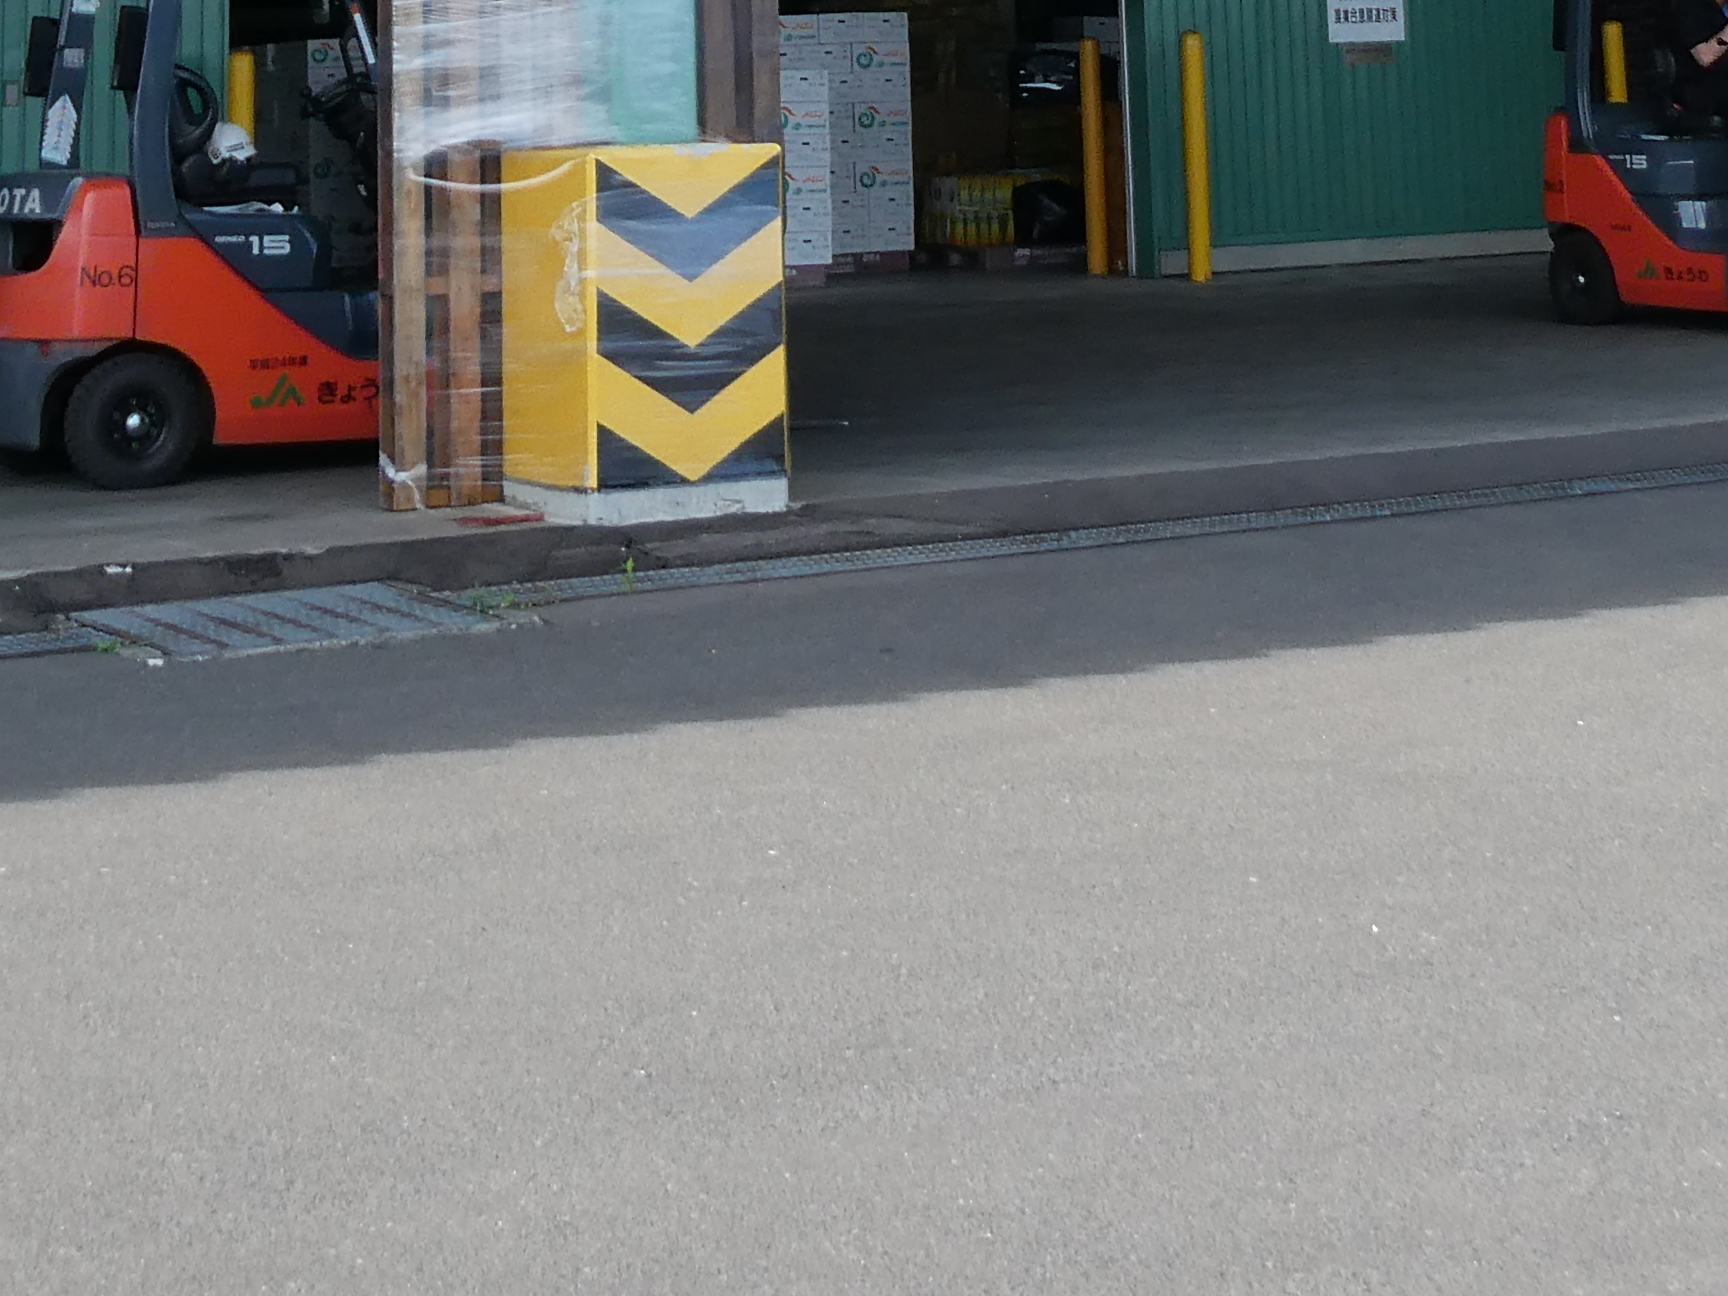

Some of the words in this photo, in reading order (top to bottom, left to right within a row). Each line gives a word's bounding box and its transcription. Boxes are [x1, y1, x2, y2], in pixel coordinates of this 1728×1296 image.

[1624, 154, 1648, 169] 15
[248, 234, 291, 255] 15
[80, 264, 136, 288] No.6
